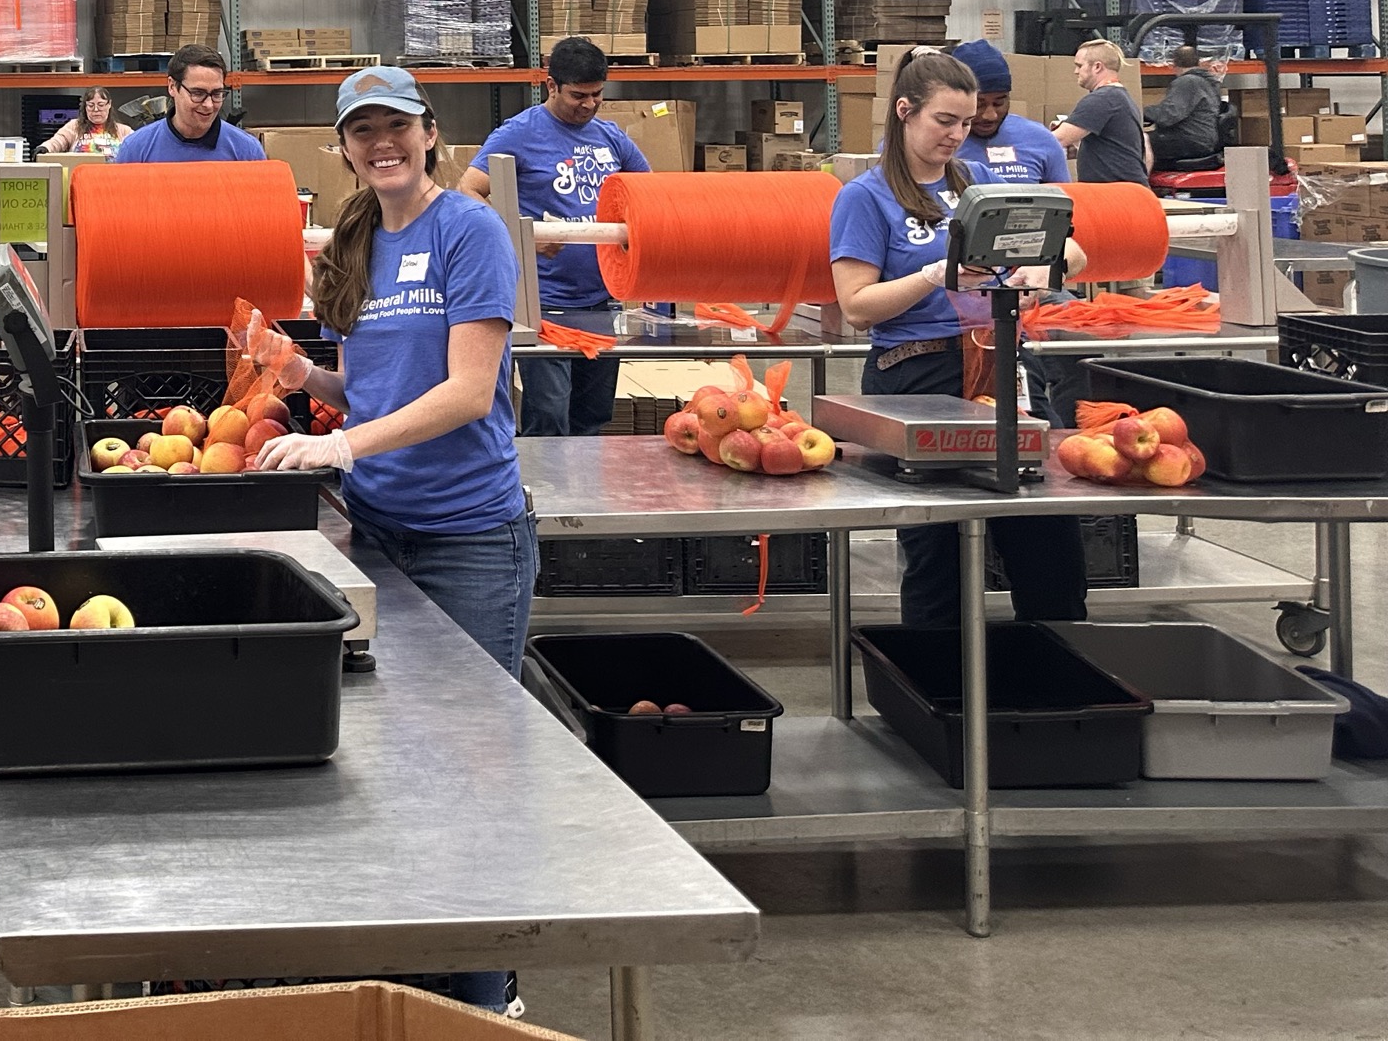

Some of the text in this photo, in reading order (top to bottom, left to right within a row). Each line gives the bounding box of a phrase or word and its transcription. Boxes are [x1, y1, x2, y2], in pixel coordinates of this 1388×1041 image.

[360, 288, 444, 312] General Mills
[379, 308, 395, 318] Food
[396, 306, 421, 315] People
[423, 306, 445, 314] Love
[941, 429, 1035, 449] Defener
